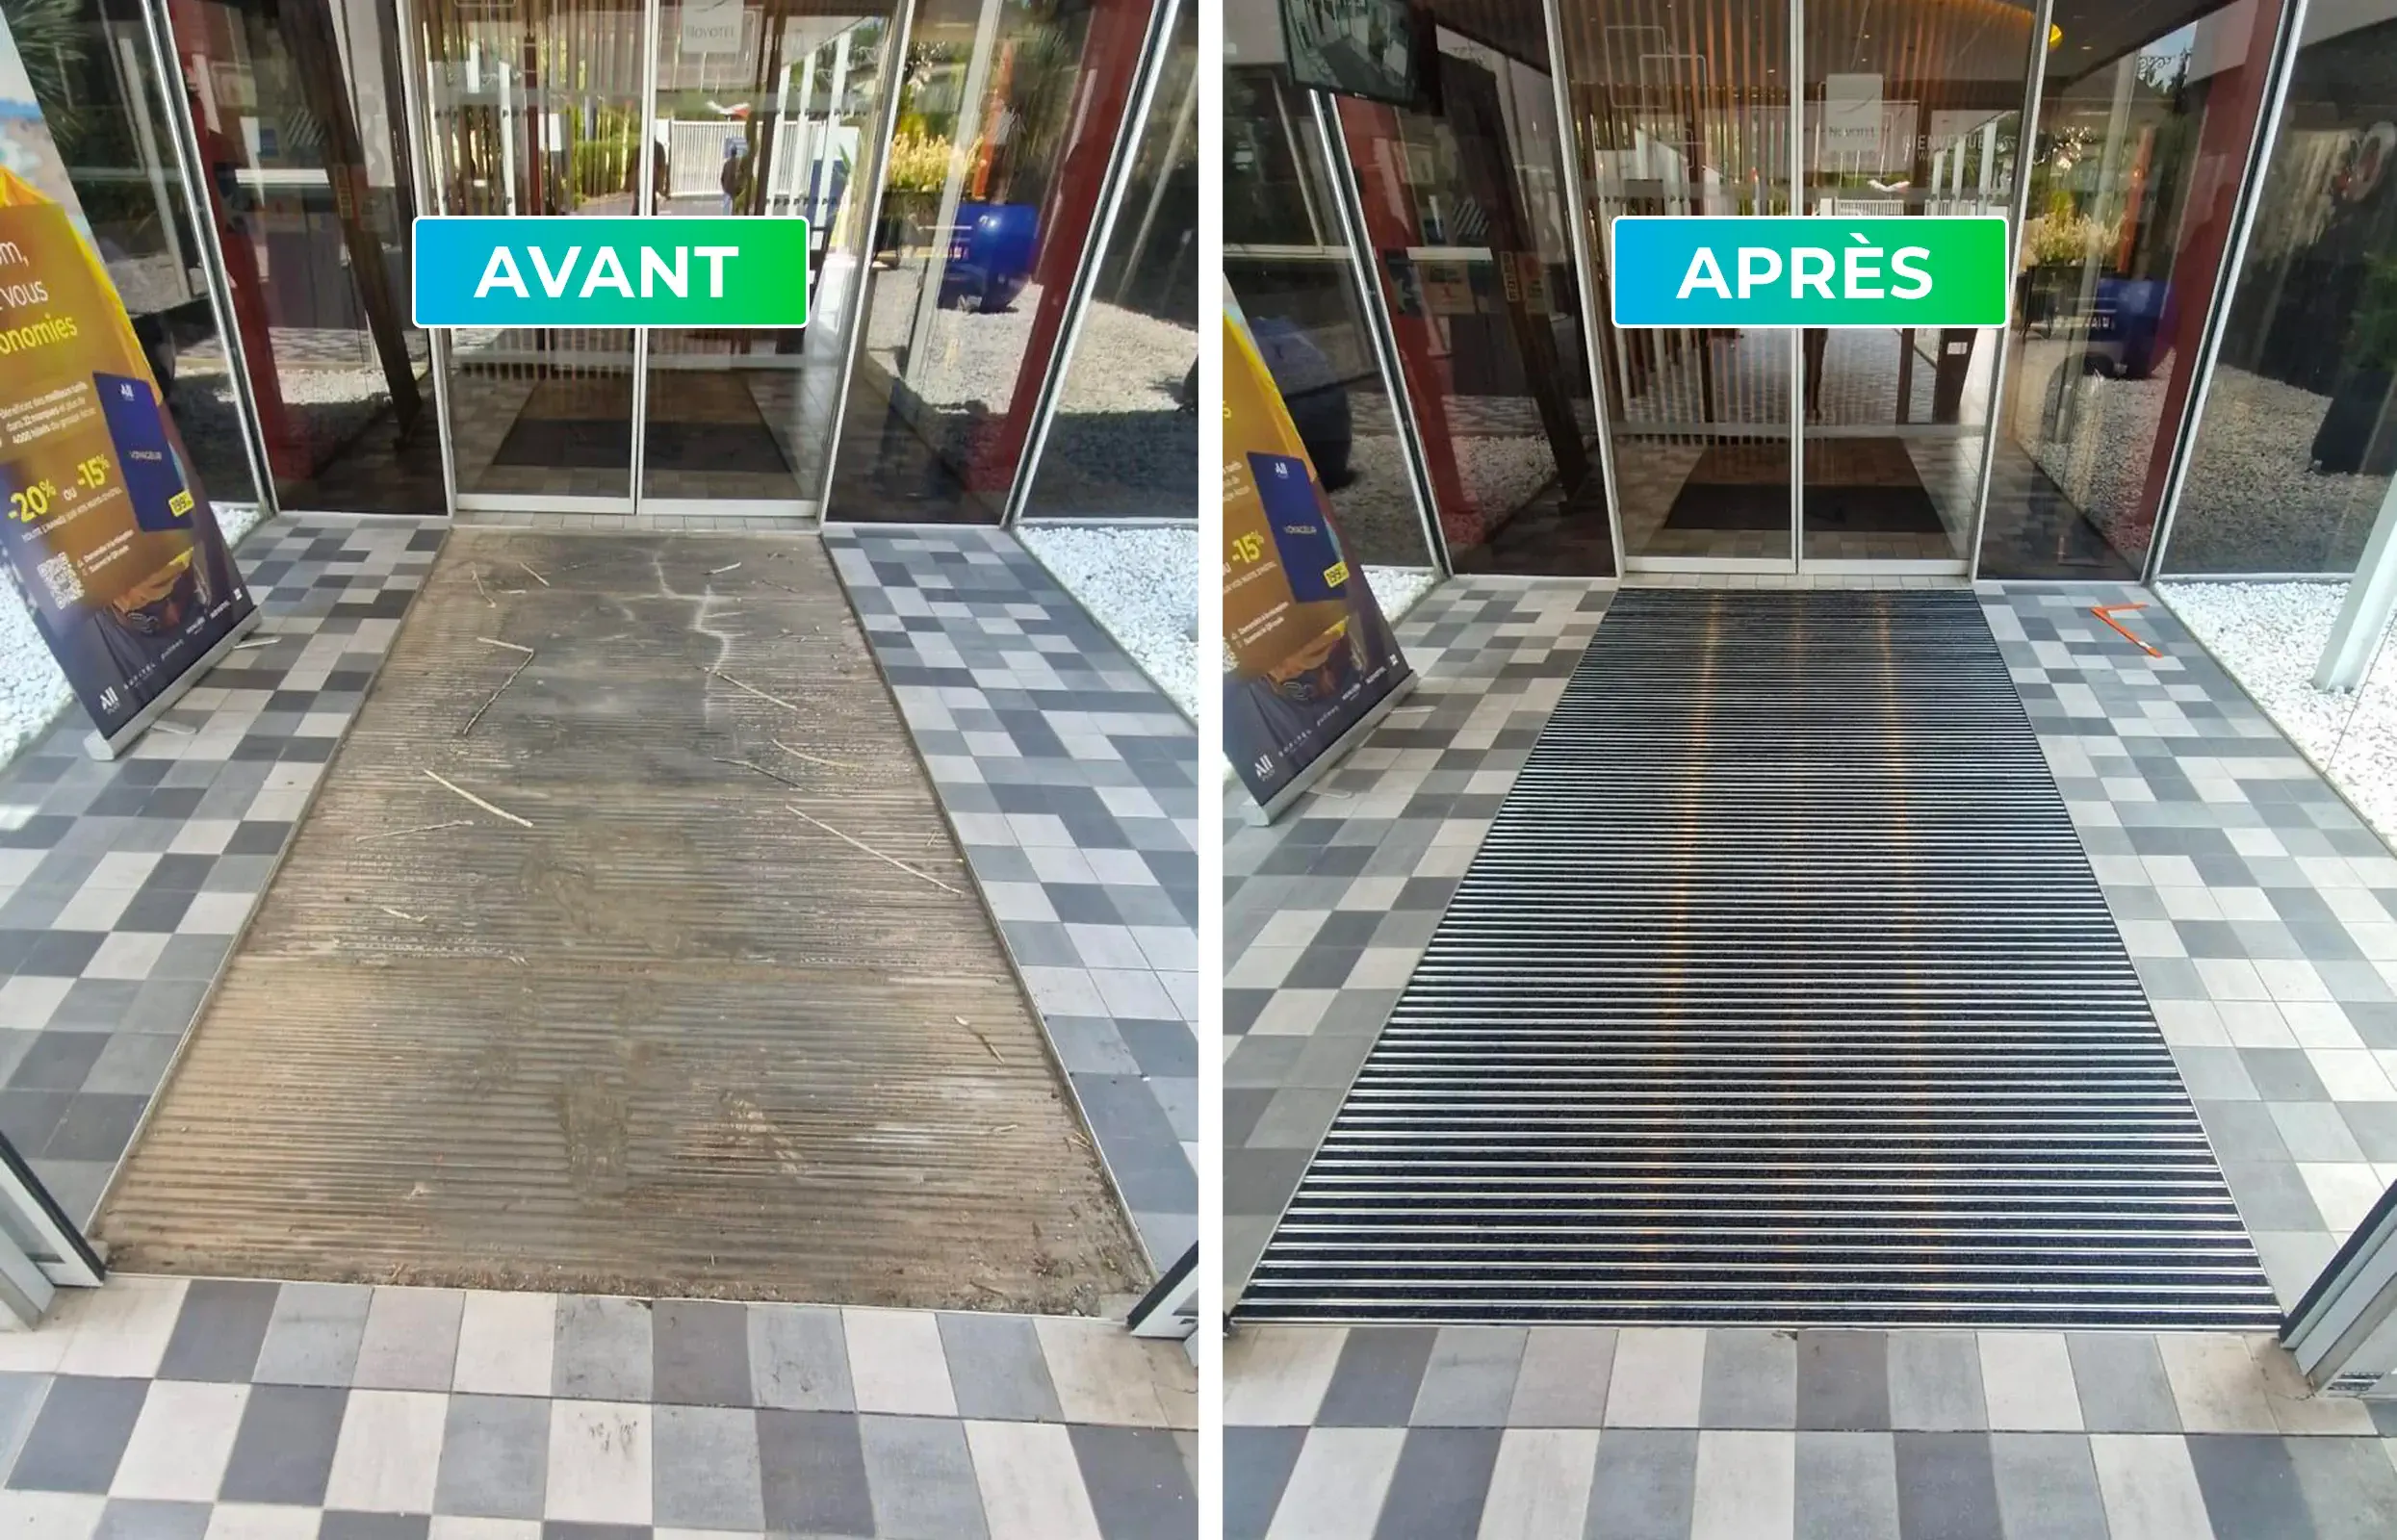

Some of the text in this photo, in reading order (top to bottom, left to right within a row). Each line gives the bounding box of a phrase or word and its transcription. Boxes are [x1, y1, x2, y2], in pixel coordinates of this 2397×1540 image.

[1, 280, 49, 308] vous
[8, 478, 57, 524] -20%
[77, 453, 111, 489] -15%
[1232, 529, 1264, 563] -15%
